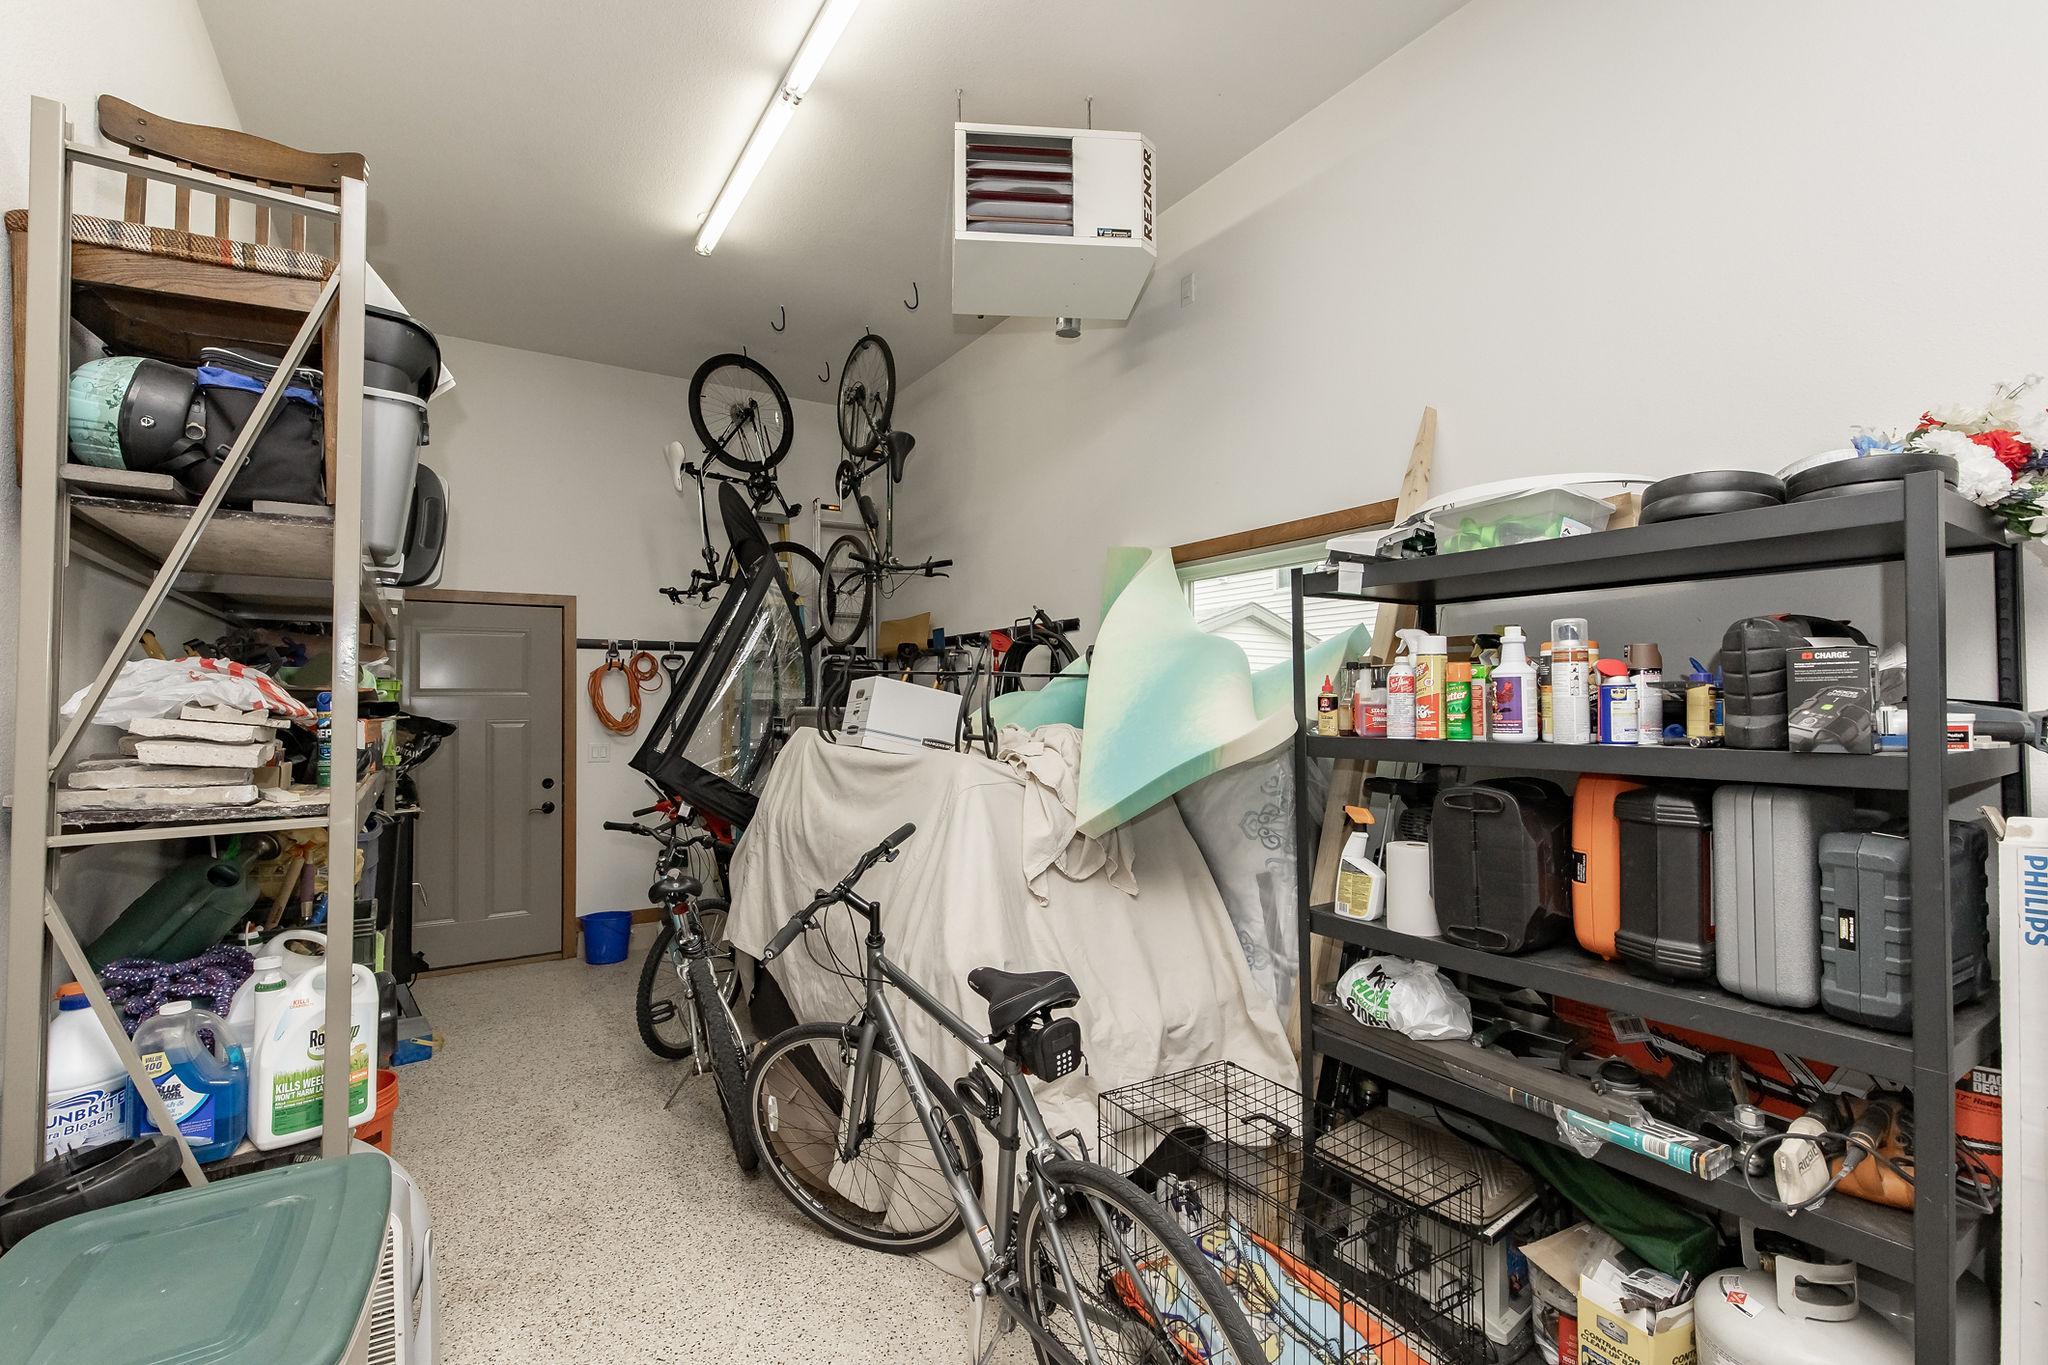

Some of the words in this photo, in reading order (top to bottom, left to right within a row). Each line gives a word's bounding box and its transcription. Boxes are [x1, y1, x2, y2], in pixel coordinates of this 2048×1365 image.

[1143, 148, 1153, 241] REZNOR
[2023, 855, 2048, 946] PHILIPS
[144, 1061, 163, 1071] 100
[145, 1055, 163, 1063] VALUE
[886, 1029, 924, 1106] TREK
[275, 1081, 301, 1095] KILLS
[302, 1074, 325, 1089] WEE
[1972, 1071, 2002, 1086] BLAC
[1972, 1081, 2002, 1097] DEC
[275, 1091, 296, 1102] WON'T
[296, 1087, 315, 1097] HARM
[46, 1090, 126, 1130] UNBRITE
[63, 1112, 113, 1136] Bleach
[1580, 1333, 1620, 1360] CLEAN-UP
[1583, 1328, 1641, 1365] CONTRACTOR
